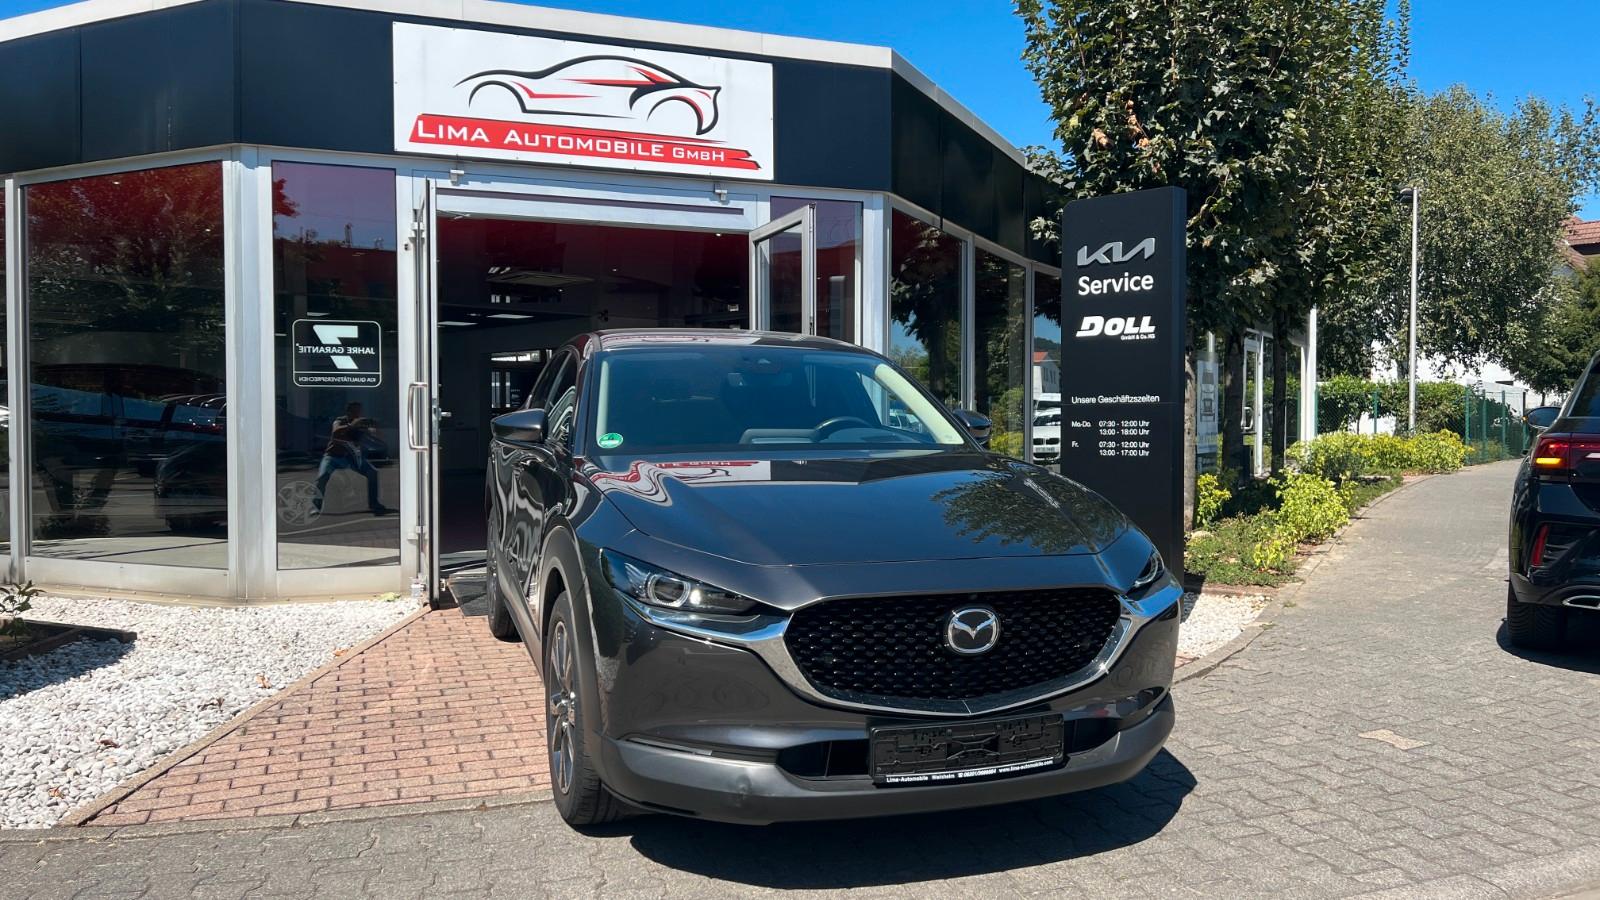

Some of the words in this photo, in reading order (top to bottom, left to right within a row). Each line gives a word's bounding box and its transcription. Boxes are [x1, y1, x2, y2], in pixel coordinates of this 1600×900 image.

[417, 119, 490, 143] LIMA
[1077, 238, 1155, 266] KIA
[1078, 272, 1154, 296] Service
[1075, 315, 1156, 337] DOLL
[1071, 396, 1097, 404] Unsere
[1099, 428, 1116, 436] 13:00
[1120, 428, 1138, 436] 18:00
[1138, 428, 1150, 436] Uhr
[1138, 449, 1150, 457] Uhr
